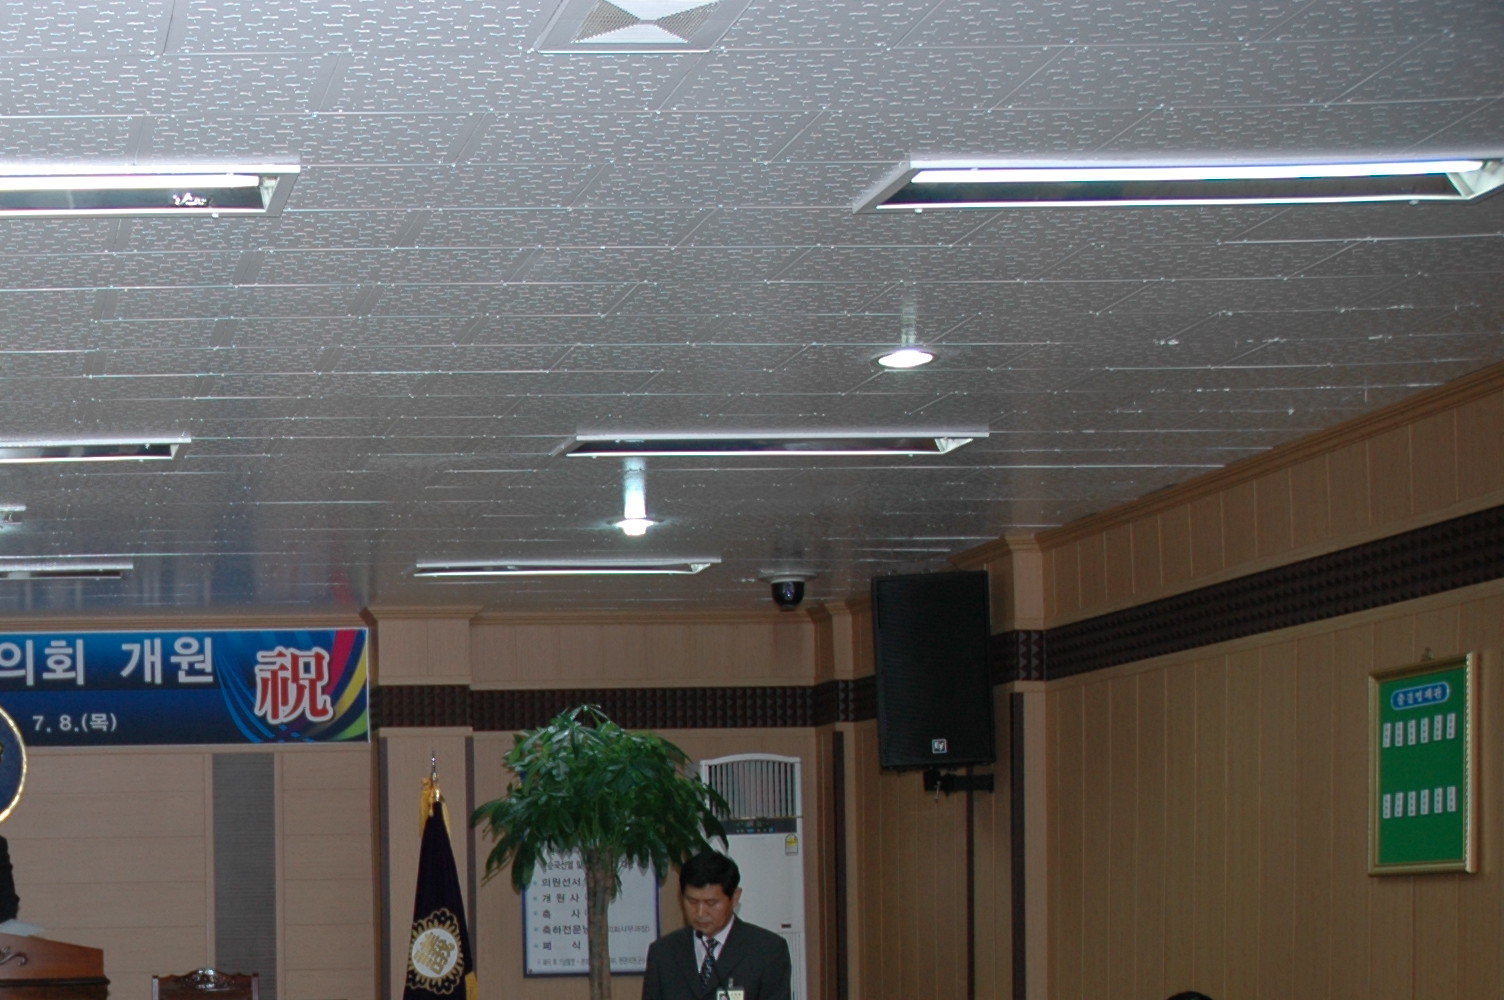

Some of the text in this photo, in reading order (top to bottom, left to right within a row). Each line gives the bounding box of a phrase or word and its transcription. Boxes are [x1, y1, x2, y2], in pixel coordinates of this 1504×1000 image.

[120, 636, 214, 685] 개원
[254, 646, 334, 724] 祝
[32, 714, 51, 732] 7.
